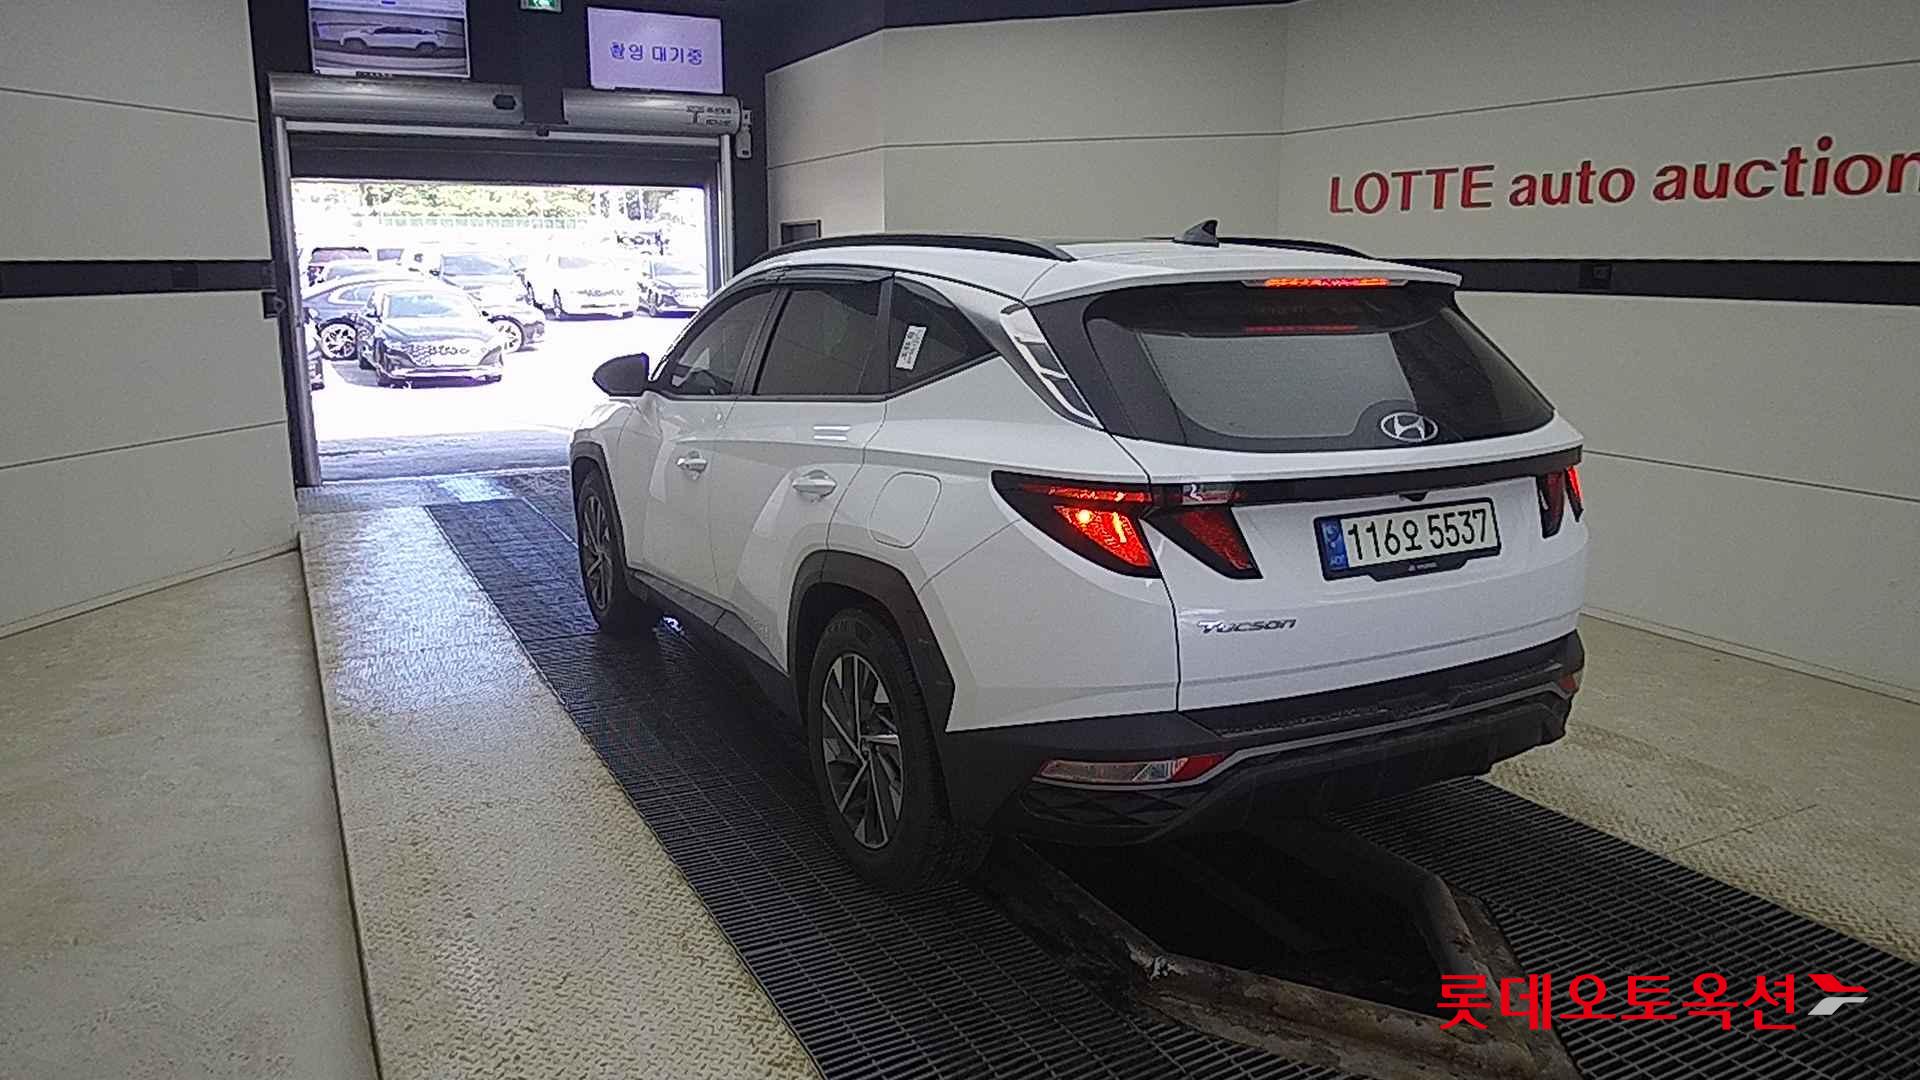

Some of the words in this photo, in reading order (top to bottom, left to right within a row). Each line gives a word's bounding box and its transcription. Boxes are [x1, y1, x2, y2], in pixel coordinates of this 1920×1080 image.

[651, 46, 703, 66] 대기중
[1329, 164, 1495, 214] LOTTE
[1508, 160, 1636, 207] auto
[1652, 135, 1920, 201] auction
[1348, 519, 1423, 560] 116오
[1427, 508, 1487, 549] 5537
